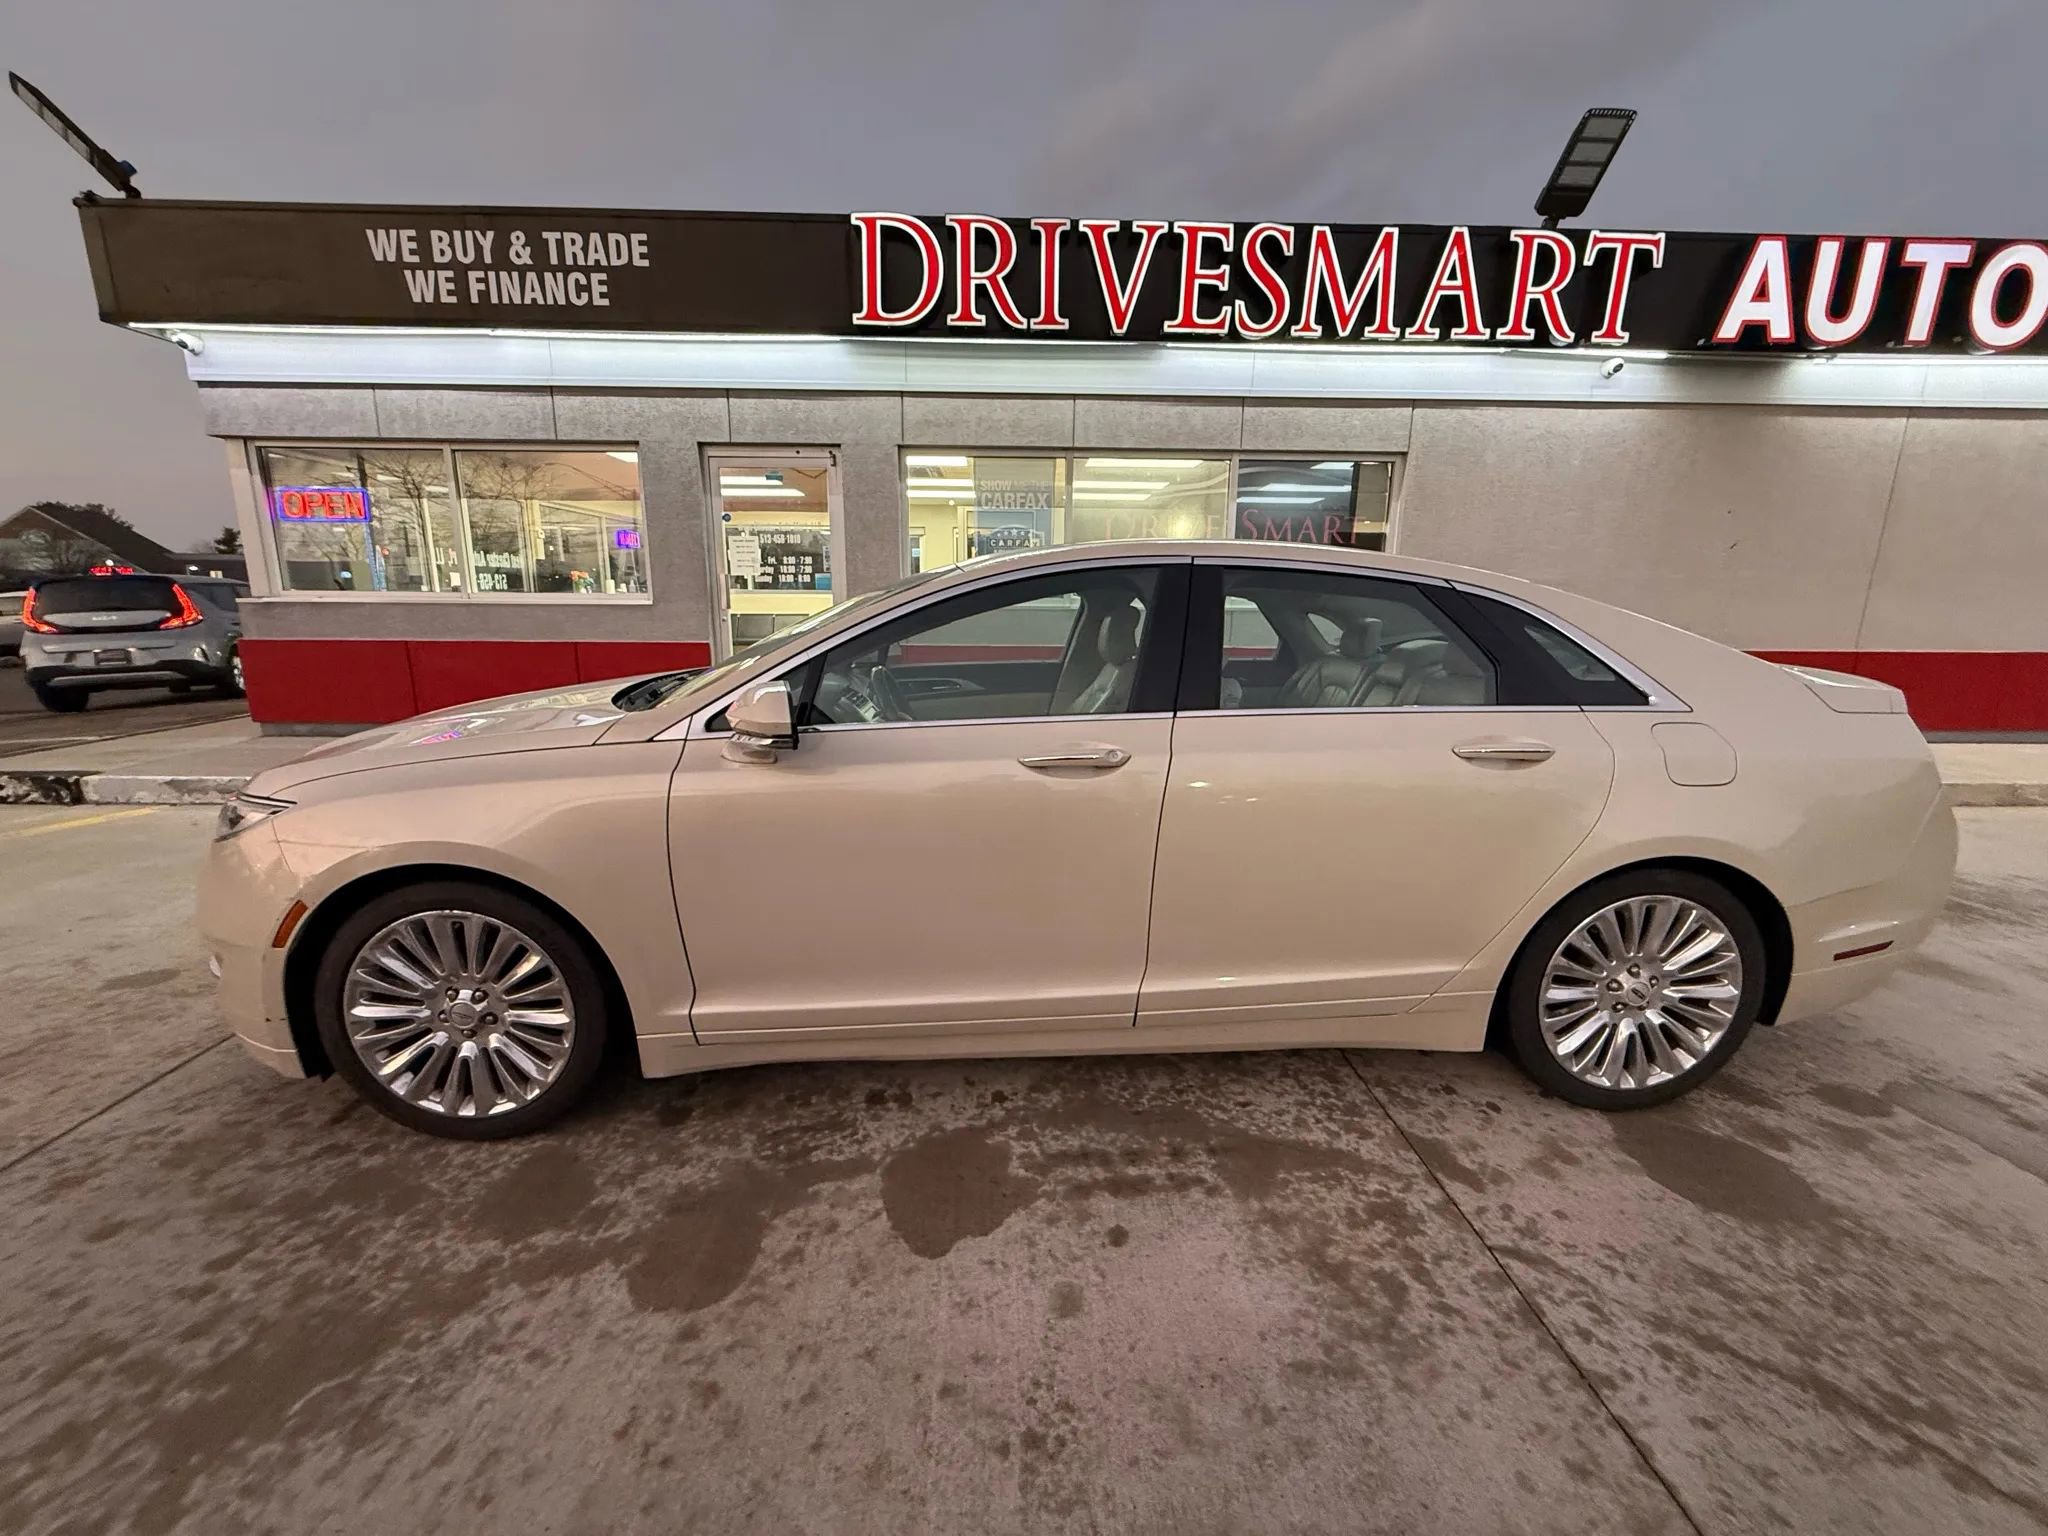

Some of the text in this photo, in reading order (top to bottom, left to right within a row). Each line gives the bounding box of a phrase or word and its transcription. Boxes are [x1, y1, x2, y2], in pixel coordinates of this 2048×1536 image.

[366, 229, 650, 267] WE BUY & TRADE
[404, 270, 611, 306] WE FINANCE
[850, 212, 2048, 353] DRIVESMART AUTO
[980, 480, 1012, 491] SHOW
[981, 492, 1049, 509] CARFAX
[283, 491, 365, 519] OPEN
[1241, 508, 1368, 544] SMART
